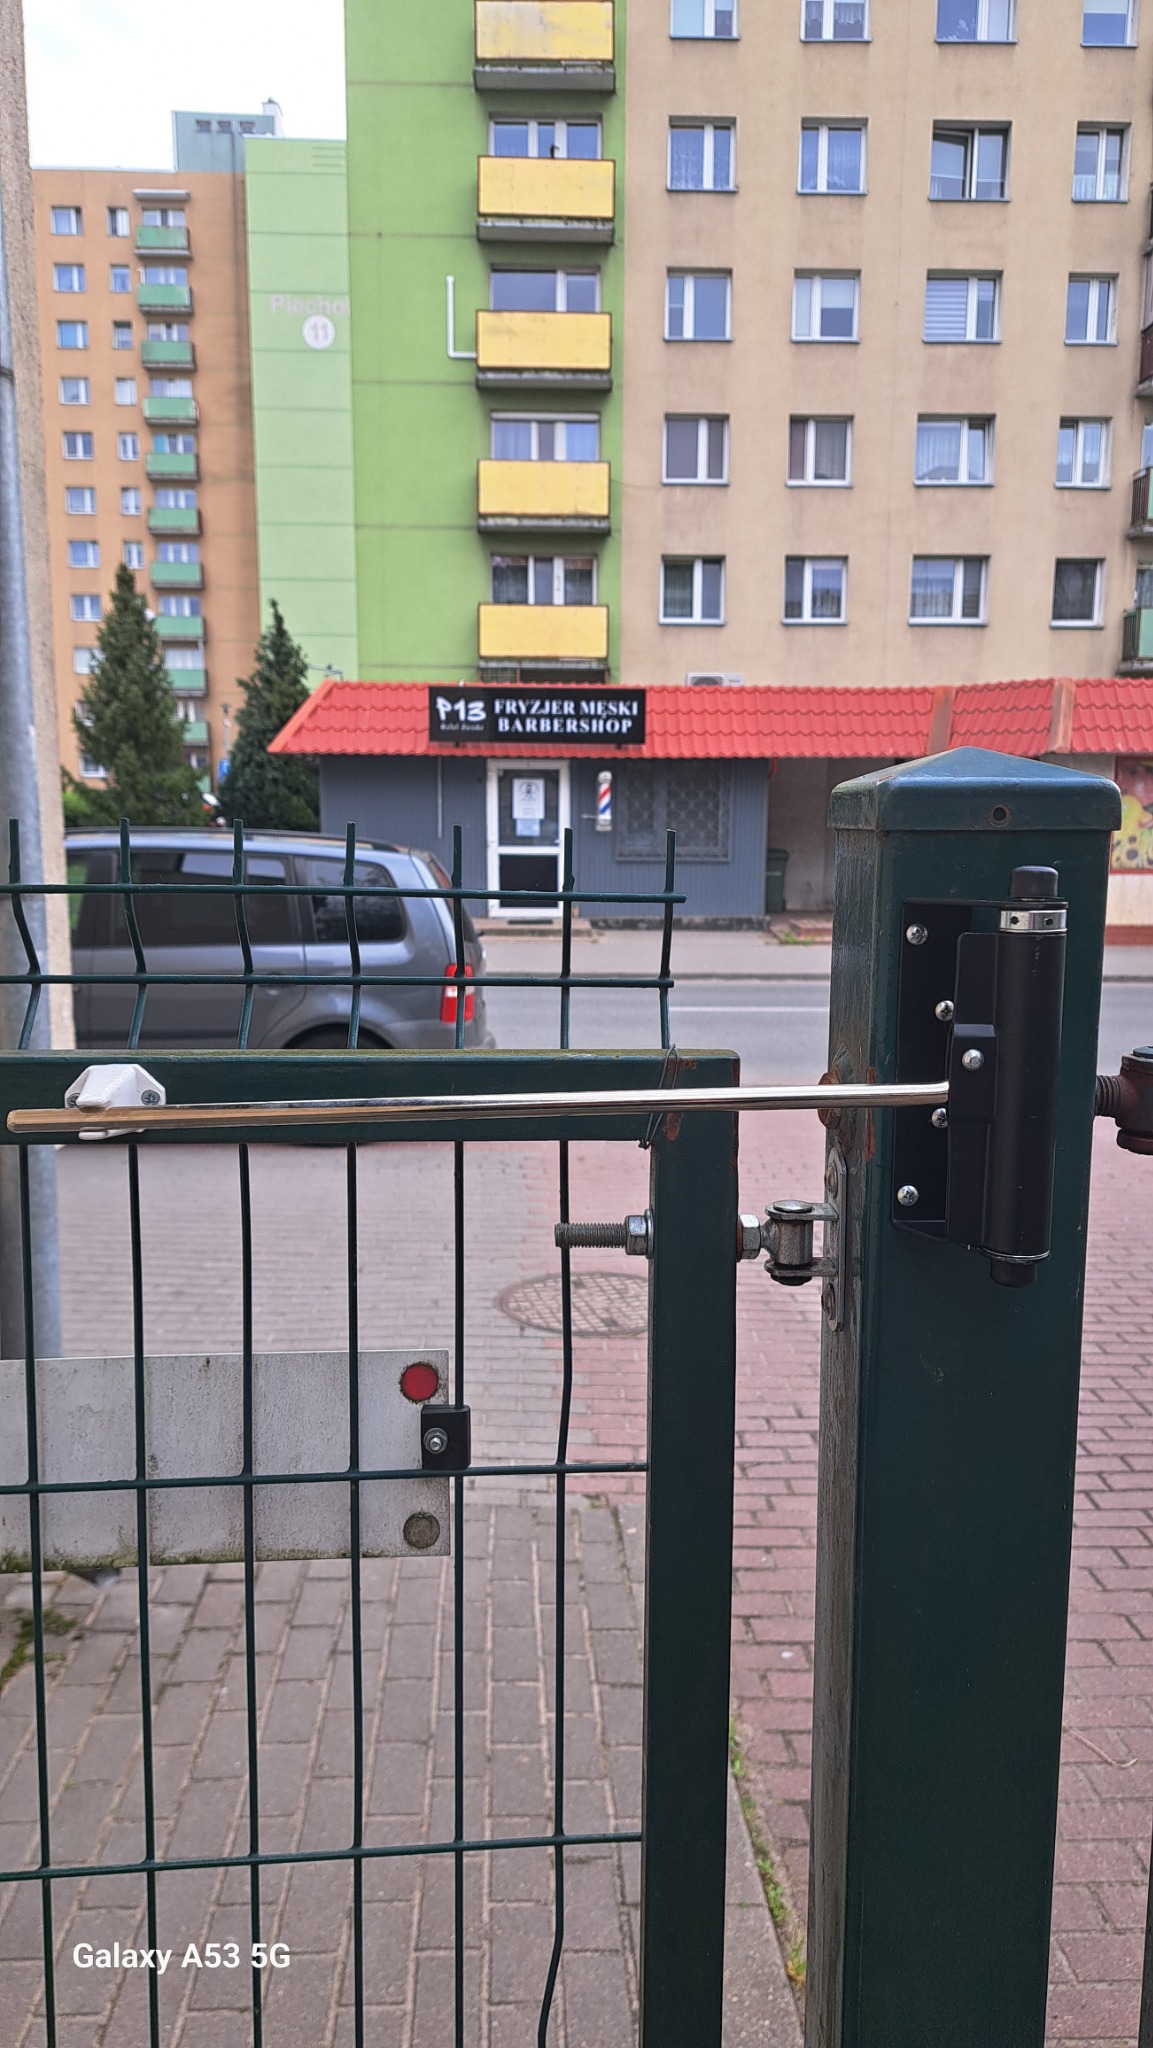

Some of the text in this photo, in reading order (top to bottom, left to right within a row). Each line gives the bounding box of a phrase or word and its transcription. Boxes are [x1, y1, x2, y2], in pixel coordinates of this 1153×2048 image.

[311, 323, 329, 342] 11
[435, 695, 487, 722] P13
[494, 698, 639, 719] FRYZJER MĘSKI
[497, 716, 633, 734] BARBERSHOP
